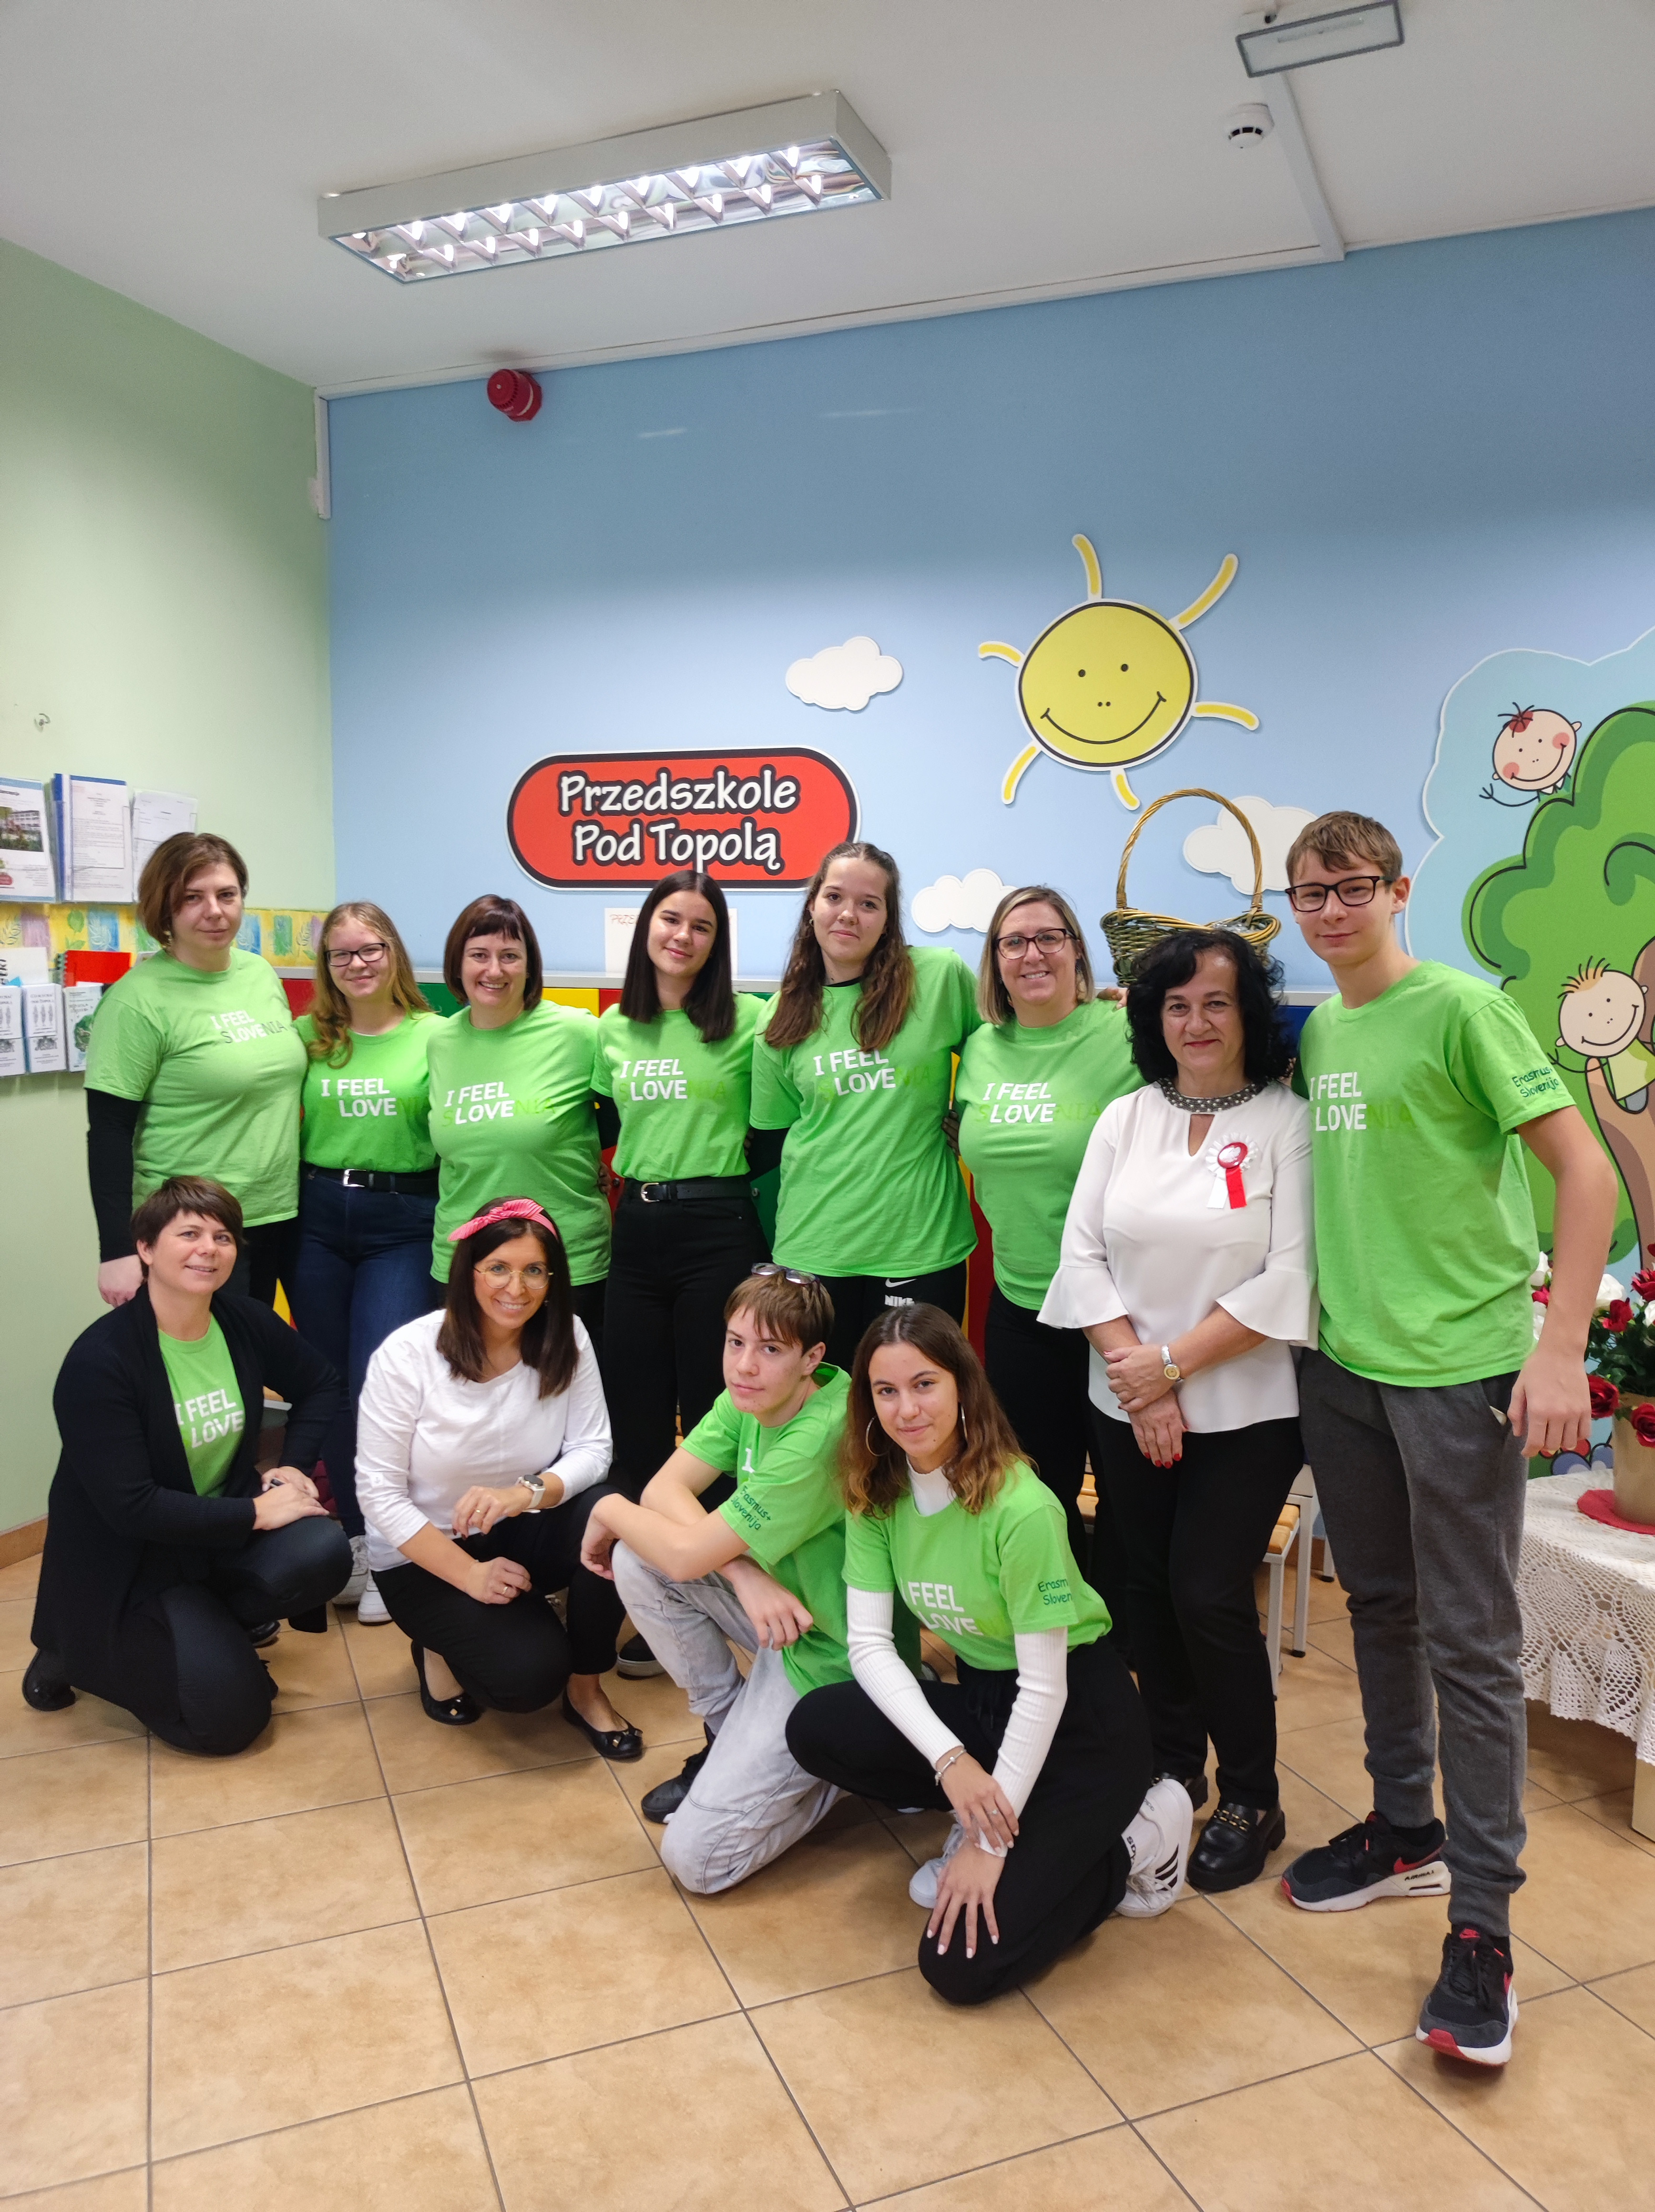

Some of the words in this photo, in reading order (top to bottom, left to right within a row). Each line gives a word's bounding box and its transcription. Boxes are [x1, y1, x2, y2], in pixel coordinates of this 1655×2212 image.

[562, 769, 797, 811] Przedszkole
[575, 823, 641, 861] Pod
[650, 822, 781, 874] Topolą
[210, 1015, 222, 1030] I
[220, 1010, 255, 1027] FEEL
[220, 1020, 288, 1044] SLOVENIA
[620, 1061, 632, 1078] I
[632, 1058, 684, 1077] FEEL
[813, 1055, 825, 1076] I
[829, 1048, 889, 1072] FEEL
[321, 1078, 331, 1097] I
[337, 1078, 390, 1096] FEEL
[444, 1090, 455, 1107] I
[458, 1081, 510, 1104] FEEL
[982, 1082, 996, 1101] I
[996, 1082, 1052, 1100] FEEL
[1317, 1072, 1362, 1100] FEEL
[884, 1294, 915, 1307] NIKE
[175, 1403, 184, 1425] I
[184, 1389, 237, 1422] FEEL
[908, 1581, 965, 1613] FEEL
